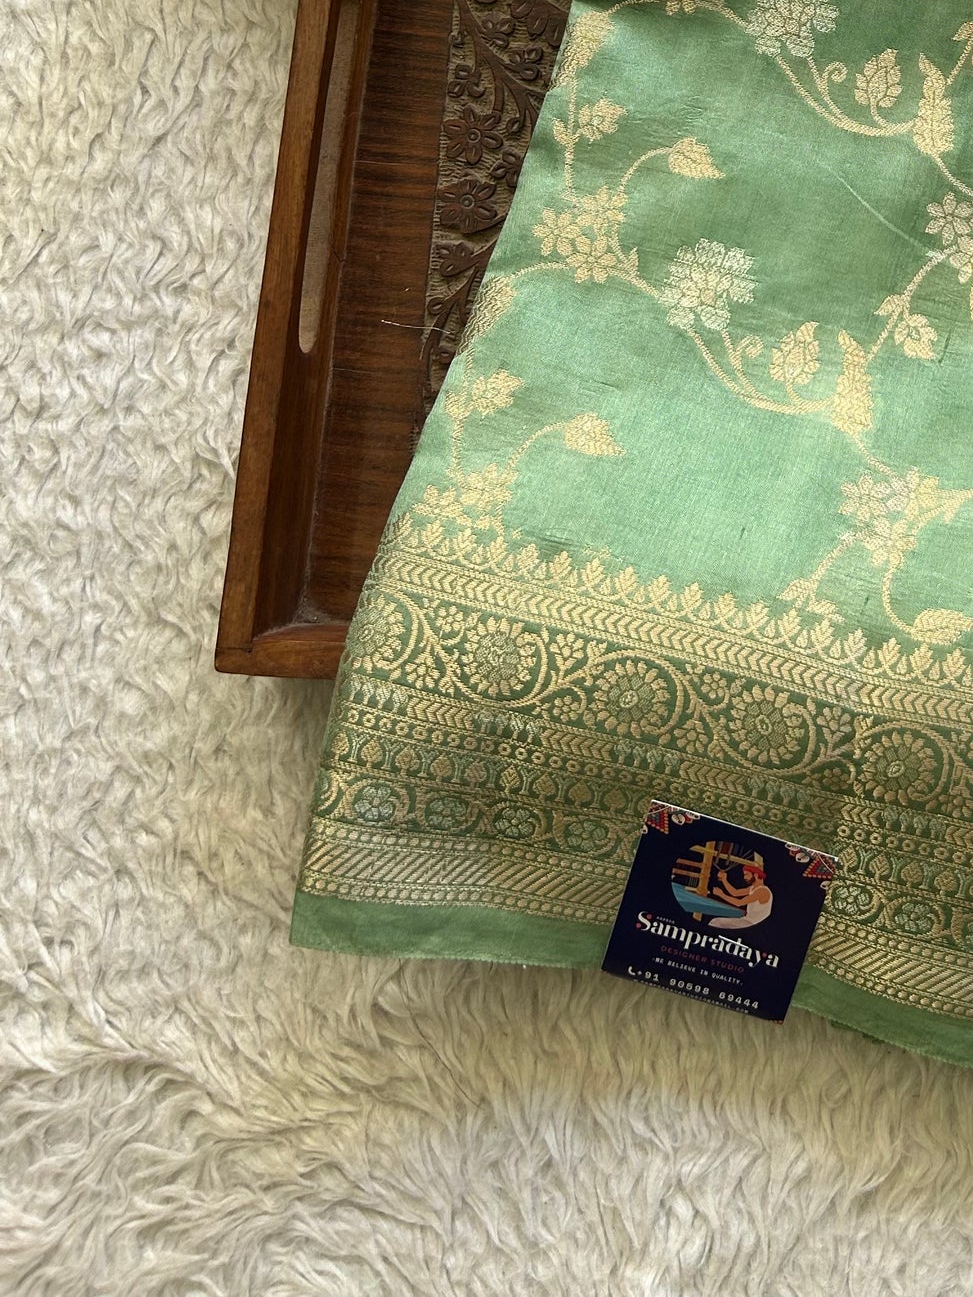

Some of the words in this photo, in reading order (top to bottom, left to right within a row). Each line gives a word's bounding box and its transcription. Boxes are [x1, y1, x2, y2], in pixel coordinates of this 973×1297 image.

[636, 910, 780, 969] Sampradaya
[660, 945, 708, 963] DESIGNER
[710, 958, 745, 973] STUDIO
[666, 959, 697, 973] BELIEVE
[668, 977, 711, 996] 90598
